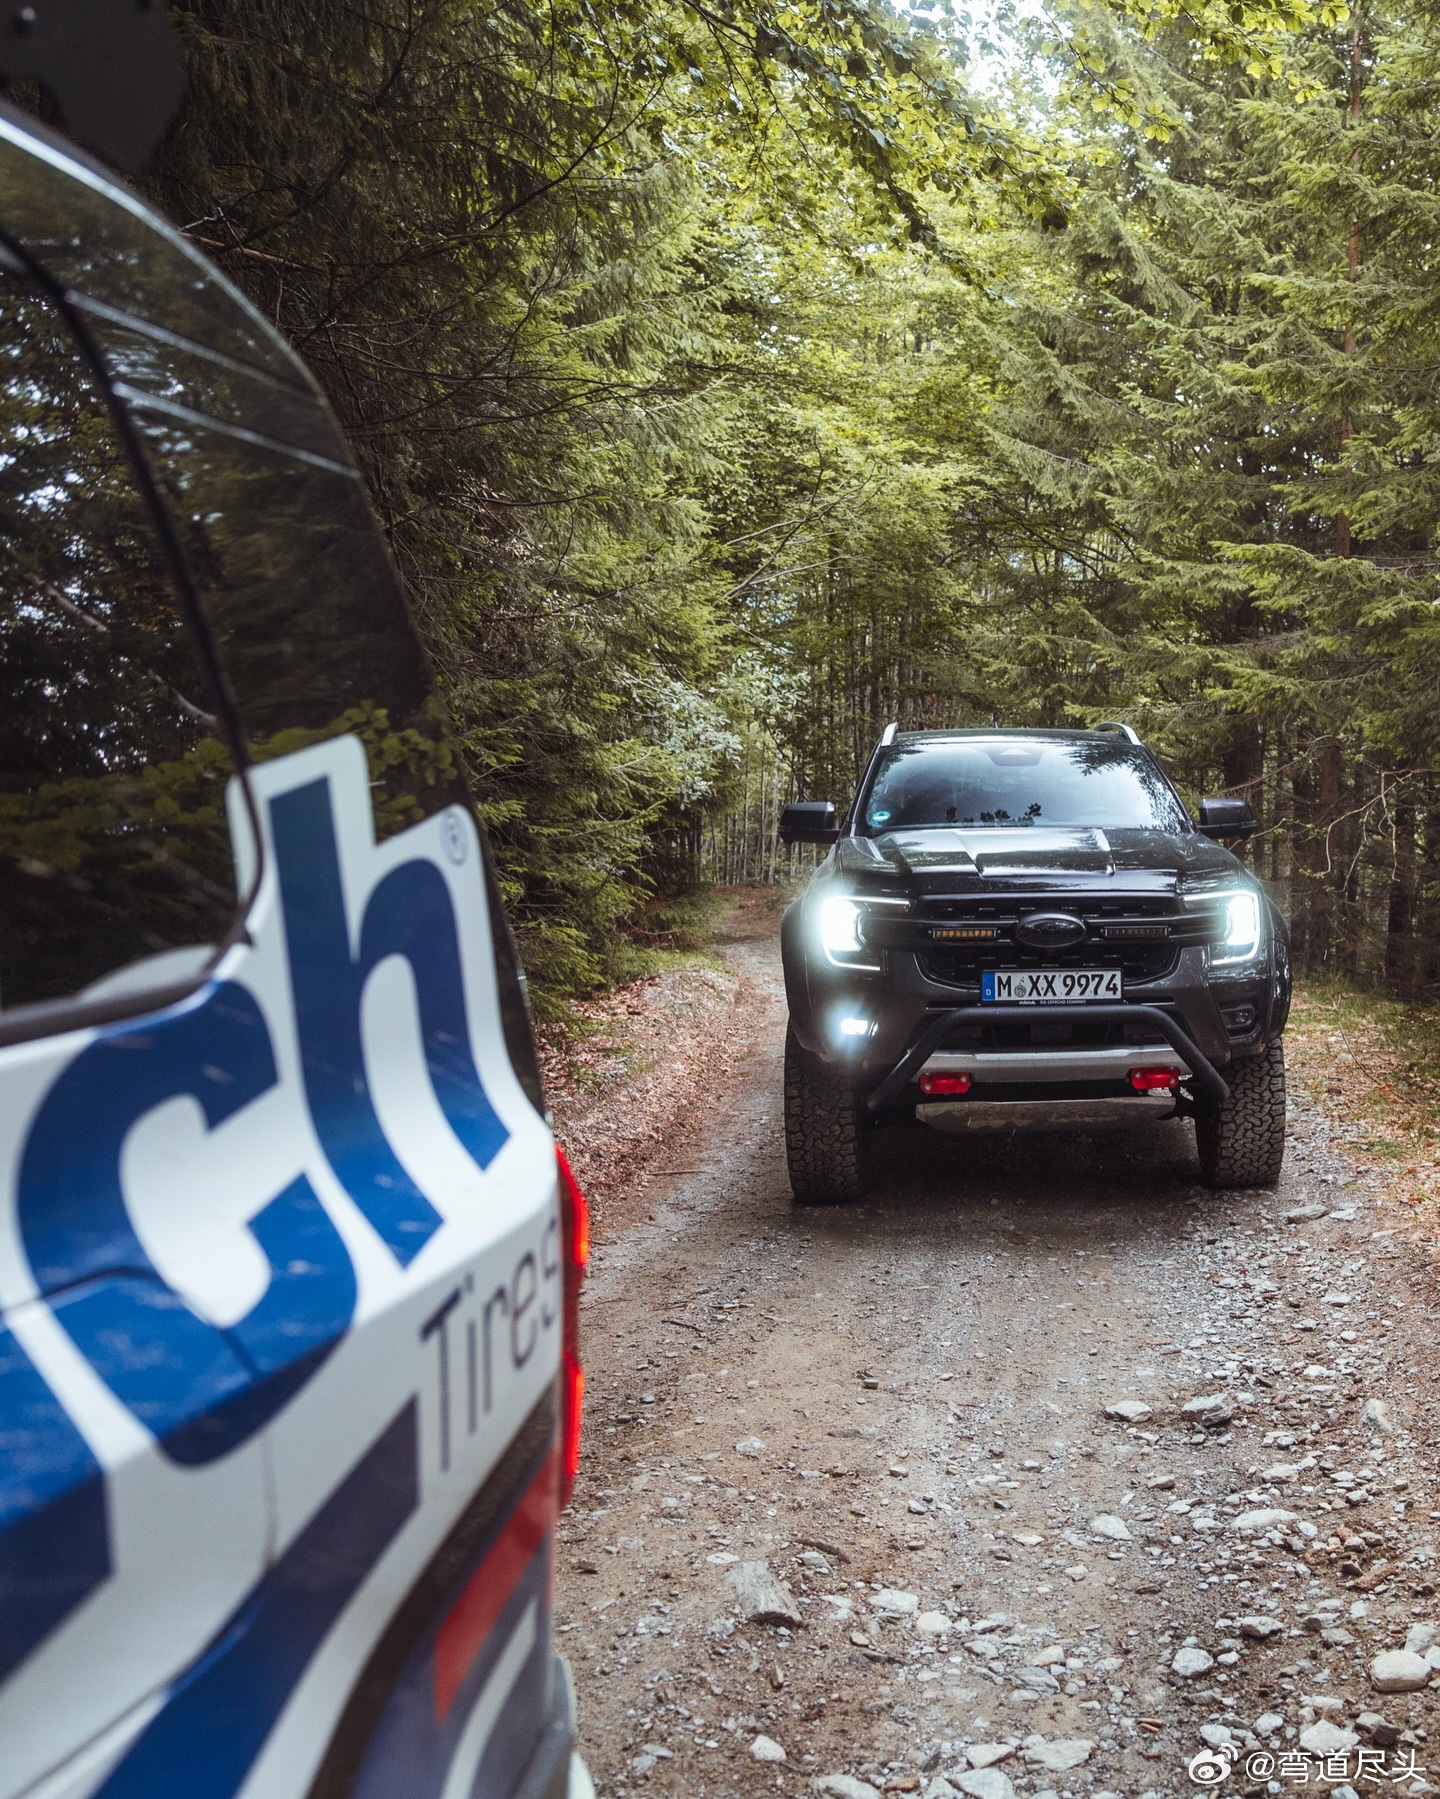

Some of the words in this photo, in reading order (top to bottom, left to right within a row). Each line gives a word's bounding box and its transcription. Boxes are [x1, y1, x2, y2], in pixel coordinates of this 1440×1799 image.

[997, 975, 1012, 997] M
[1028, 974, 1057, 996] XX
[1062, 973, 1119, 996] 9974
